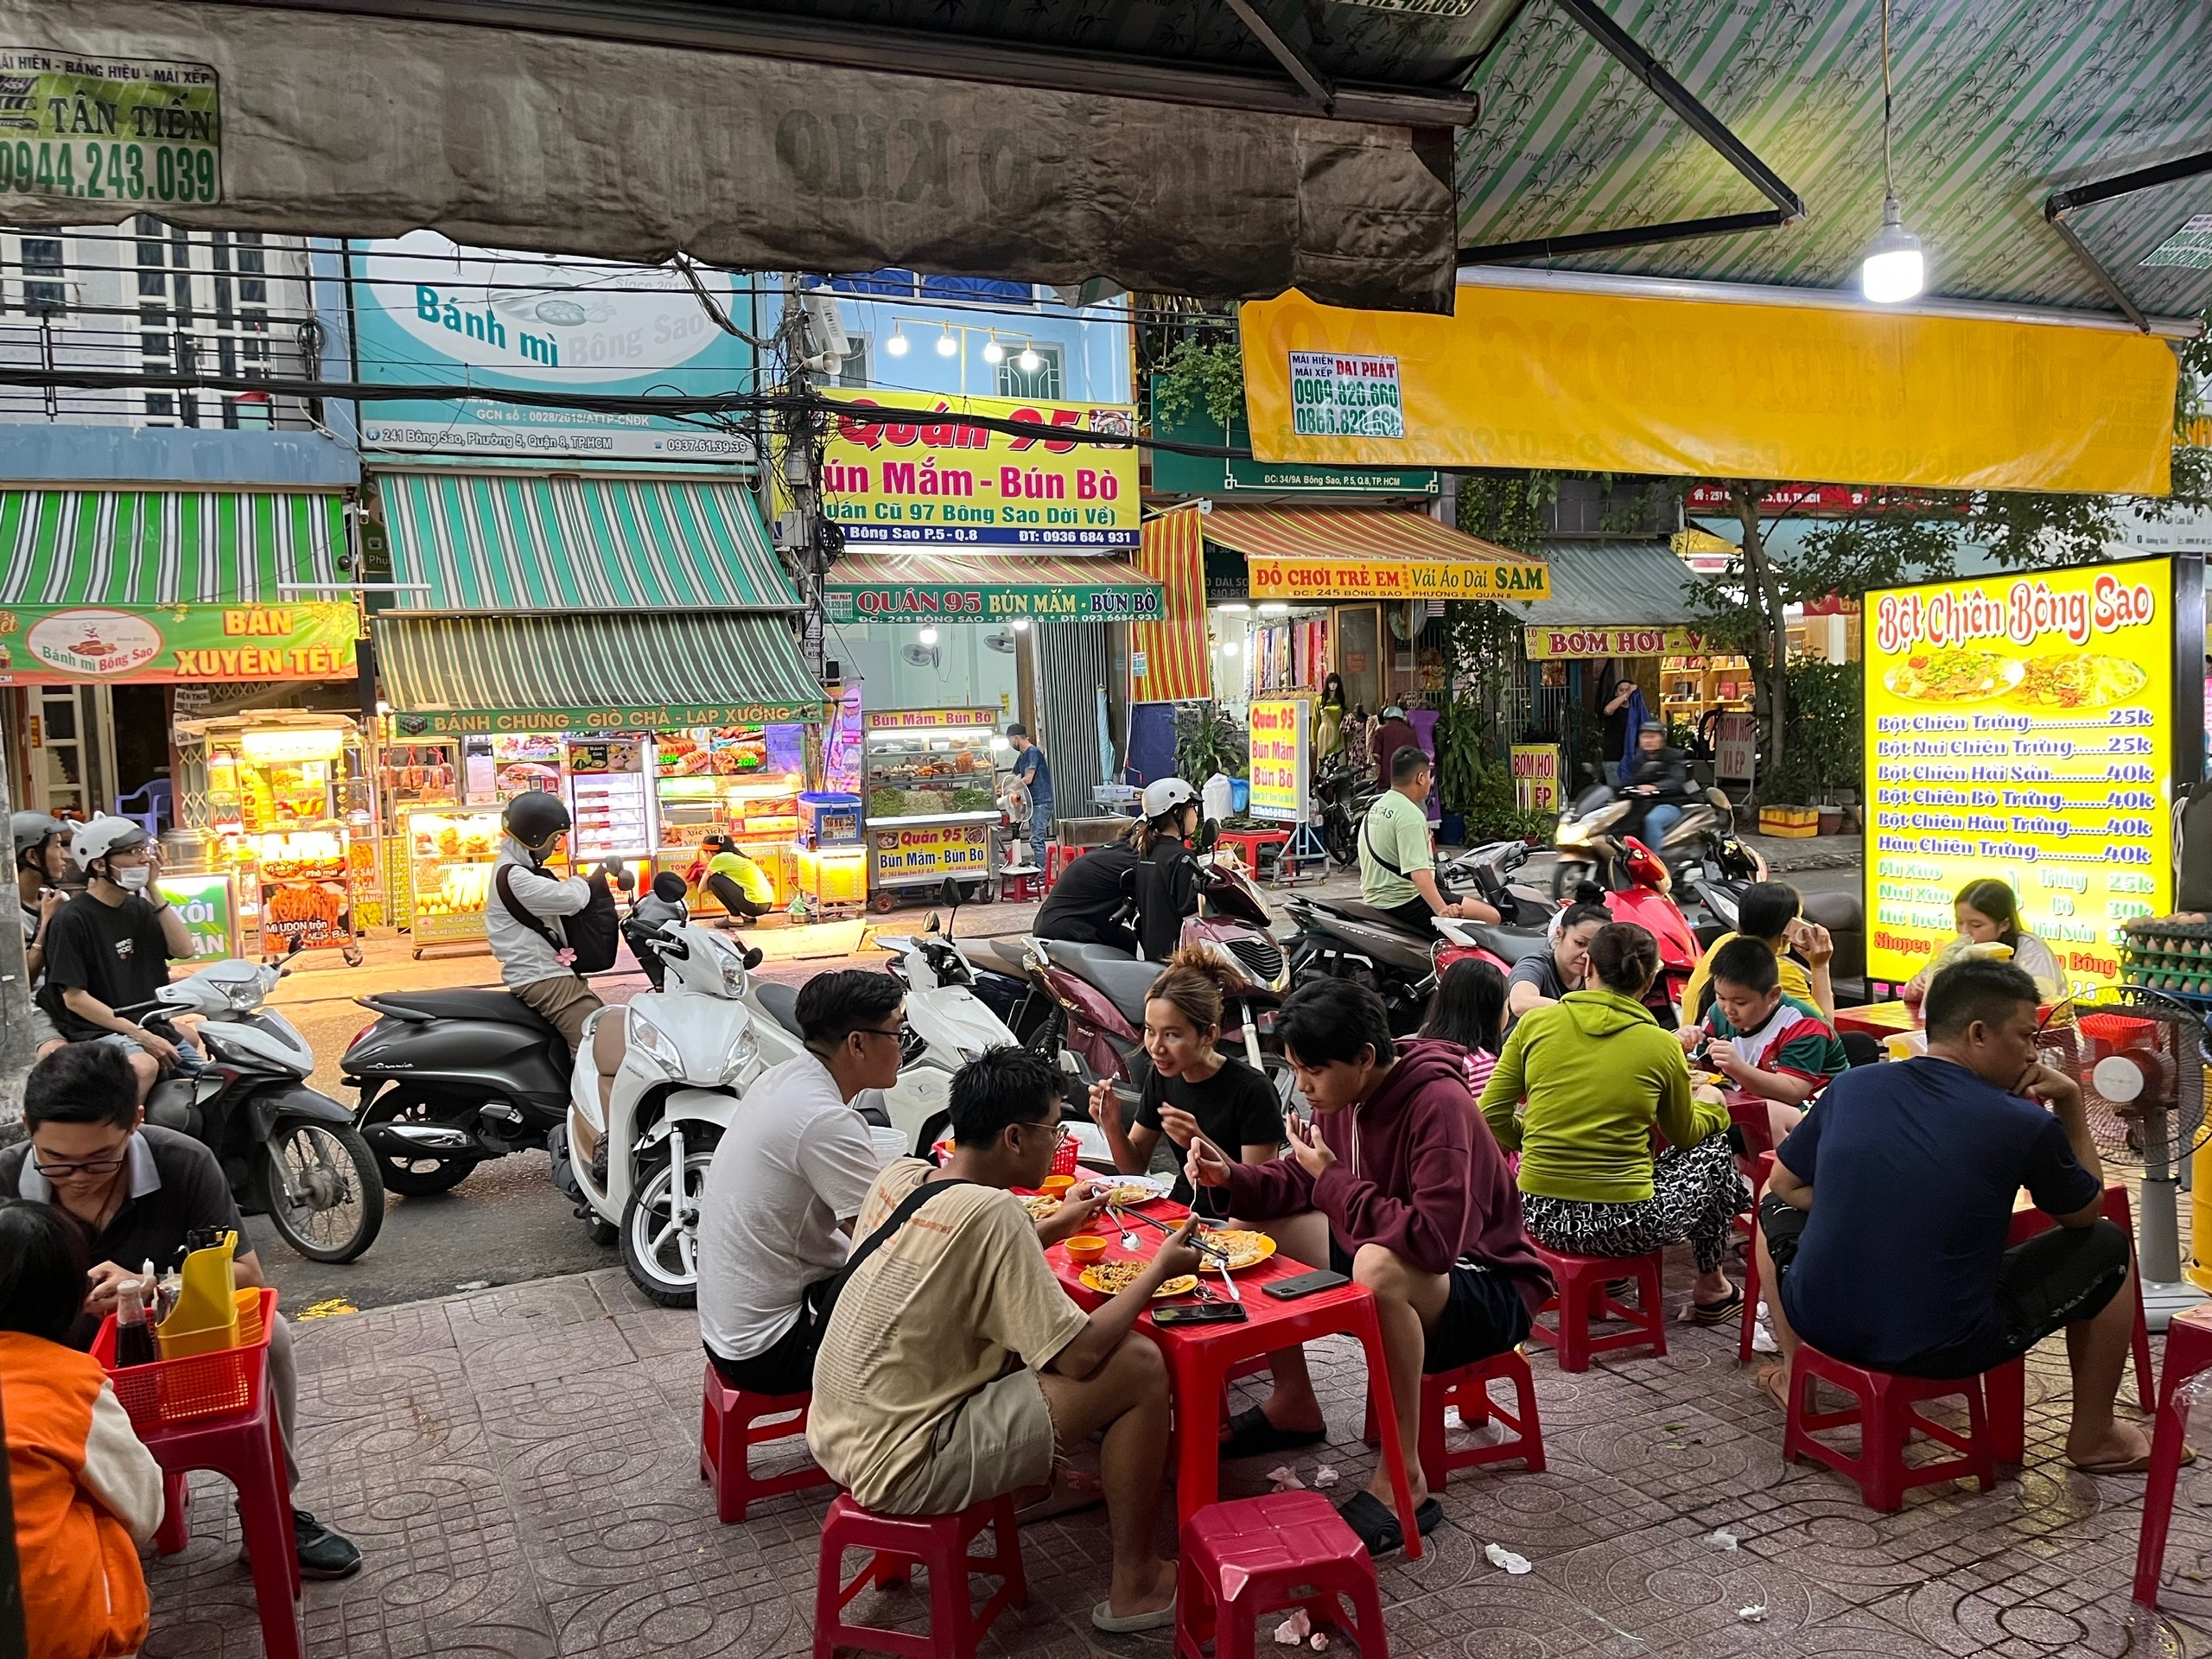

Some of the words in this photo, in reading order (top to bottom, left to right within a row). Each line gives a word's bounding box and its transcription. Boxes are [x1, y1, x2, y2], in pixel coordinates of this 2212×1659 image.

[18, 55, 51, 71] HIÊN
[65, 59, 103, 77] BẢNG
[108, 64, 140, 80] HIỆU
[154, 69, 179, 83] MÁI
[183, 67, 211, 84] XẾP
[48, 89, 118, 136] TÂN
[130, 92, 213, 141] TIẾN
[0, 141, 215, 202] 0944.243.039
[416, 286, 505, 349] Bánh
[520, 333, 558, 367] mì
[569, 326, 644, 366] Bông
[653, 313, 704, 345] Sao
[1293, 353, 1309, 364] MÁI
[1313, 354, 1333, 365] HIÊN
[1362, 359, 1395, 378] PHÁT
[1295, 365, 1313, 377] MÁI
[1315, 366, 1333, 378] XẾP
[1294, 378, 1398, 408] 0909.820.660
[476, 409, 503, 421] GCN
[505, 409, 519, 422] số
[838, 398, 989, 451] Quán
[1007, 408, 1083, 453] 95
[1297, 408, 1400, 436] 0866.820.660
[382, 429, 404, 442] 241
[406, 429, 438, 446] Bông
[440, 430, 466, 446] Sao,
[467, 432, 513, 449] Phường
[515, 435, 525, 448] 5,
[527, 435, 557, 450] Quận
[558, 435, 569, 449] 8,
[571, 436, 613, 449] TP.HCM
[667, 439, 747, 454] 0937.61.39.39
[882, 456, 974, 497] Mắm
[1001, 467, 1065, 499] Bún
[1077, 468, 1118, 501] Bò
[1280, 474, 1301, 484] 34/9A
[1303, 476, 1324, 486] Bông
[1325, 476, 1342, 486] Sao,
[1383, 477, 1401, 486] HCM
[875, 502, 902, 519] Cũ
[910, 504, 935, 521] 97
[943, 505, 995, 525] Bông
[1002, 506, 1040, 524] Sao
[1047, 506, 1078, 525] Dời
[1085, 505, 1116, 527] Về)
[850, 526, 888, 540] Bông
[893, 528, 920, 540] Sao
[1020, 531, 1039, 543] ĐT:
[1043, 531, 1077, 543] 0936
[1080, 531, 1105, 543] 684
[1108, 531, 1131, 543] 931
[1256, 562, 1283, 587] ĐỒ
[1287, 566, 1331, 586] CHƠI
[1336, 564, 1370, 587] TRẺ
[1376, 571, 1401, 587] EM
[1412, 567, 1436, 588] Vải
[1441, 564, 1459, 588] Áo
[1465, 569, 1488, 588] Dài
[1496, 567, 1545, 590] SAM
[857, 588, 939, 615] QUÁN
[944, 592, 982, 613] 95
[988, 588, 1028, 613] BÚN
[1033, 588, 1077, 613] MẮM
[1090, 588, 1128, 613] BÚN
[1133, 588, 1157, 613] BÒ
[1412, 589, 1459, 598] PHƯỜNG
[1476, 591, 1504, 600] QUẬN
[224, 607, 294, 636] BÁN
[916, 613, 954, 623] BÔNG
[1081, 613, 1158, 622] 093.6684.931
[1877, 594, 1923, 650] Bột
[1926, 589, 2003, 645] Chiên
[2009, 581, 2086, 641] Bông
[2094, 575, 2151, 629] Sao
[1548, 630, 1609, 654] BƠM
[1617, 630, 1666, 654] HƠI
[42, 645, 77, 668] Bánh
[80, 656, 96, 671] mì
[99, 654, 129, 672] Bông
[132, 645, 153, 661] Sao
[174, 644, 283, 677] XUYÊN
[290, 640, 346, 675] TẾT
[434, 715, 491, 732] BÁNH
[497, 712, 570, 730] CHƯNG
[586, 709, 624, 727] GIÒ
[628, 706, 671, 726] CHẢ
[724, 702, 791, 723] XƯỞNG
[872, 714, 898, 727] Bún
[902, 710, 936, 725] Mắm
[945, 711, 970, 724] Bún
[975, 710, 991, 723] Bò
[1253, 707, 1278, 733] Quán
[1281, 707, 1295, 731] 95
[1719, 716, 1737, 741] BƠM
[1878, 717, 1910, 733] Bột
[1913, 715, 1967, 730] Chiên
[2109, 710, 2152, 726] 25k
[658, 753, 678, 763] 20K
[1252, 739, 1269, 760] Bún
[1272, 736, 1295, 760] Mắm
[1878, 741, 1910, 759] Bột
[1913, 740, 1948, 755] Nui
[1950, 740, 2006, 755] Chiên
[2108, 737, 2152, 753] 25k
[737, 758, 757, 766] 20K
[1514, 752, 1534, 778] BƠM
[1537, 753, 1554, 779] HƠI
[1878, 766, 1910, 783] Bột
[1913, 764, 1967, 781] Chiên
[2107, 765, 2153, 781] 40k
[1254, 766, 1274, 787] Bún
[1279, 767, 1294, 789] Bò
[1878, 789, 1910, 806] Bột
[1913, 790, 1967, 805] Chiên
[1972, 790, 1998, 805] Bò
[2107, 791, 2153, 808] 40k
[1878, 813, 1910, 830] Bột
[1913, 815, 1962, 830] Chiên
[1967, 815, 2006, 831] Hàu
[2107, 819, 2152, 835] 40k
[900, 831, 939, 848] Quán
[942, 828, 963, 842] 95
[1878, 836, 1916, 852] Hàu
[1919, 839, 1974, 855] Chiên
[2104, 847, 2152, 862] 40k
[661, 852, 696, 861] HAMBURGER
[880, 853, 902, 868] Bún
[906, 848, 936, 866] Mắm
[944, 850, 966, 863] Bún
[969, 847, 984, 861] Bò
[2107, 873, 2153, 893] 25k
[1878, 884, 1912, 901] Nui
[2107, 899, 2152, 919] 30k
[280, 920, 308, 932] UDON
[308, 919, 327, 931] trộn
[1874, 931, 1931, 956] Shopee
[2069, 953, 2117, 977] Bông
[626, 1065, 645, 1080] HONDA
